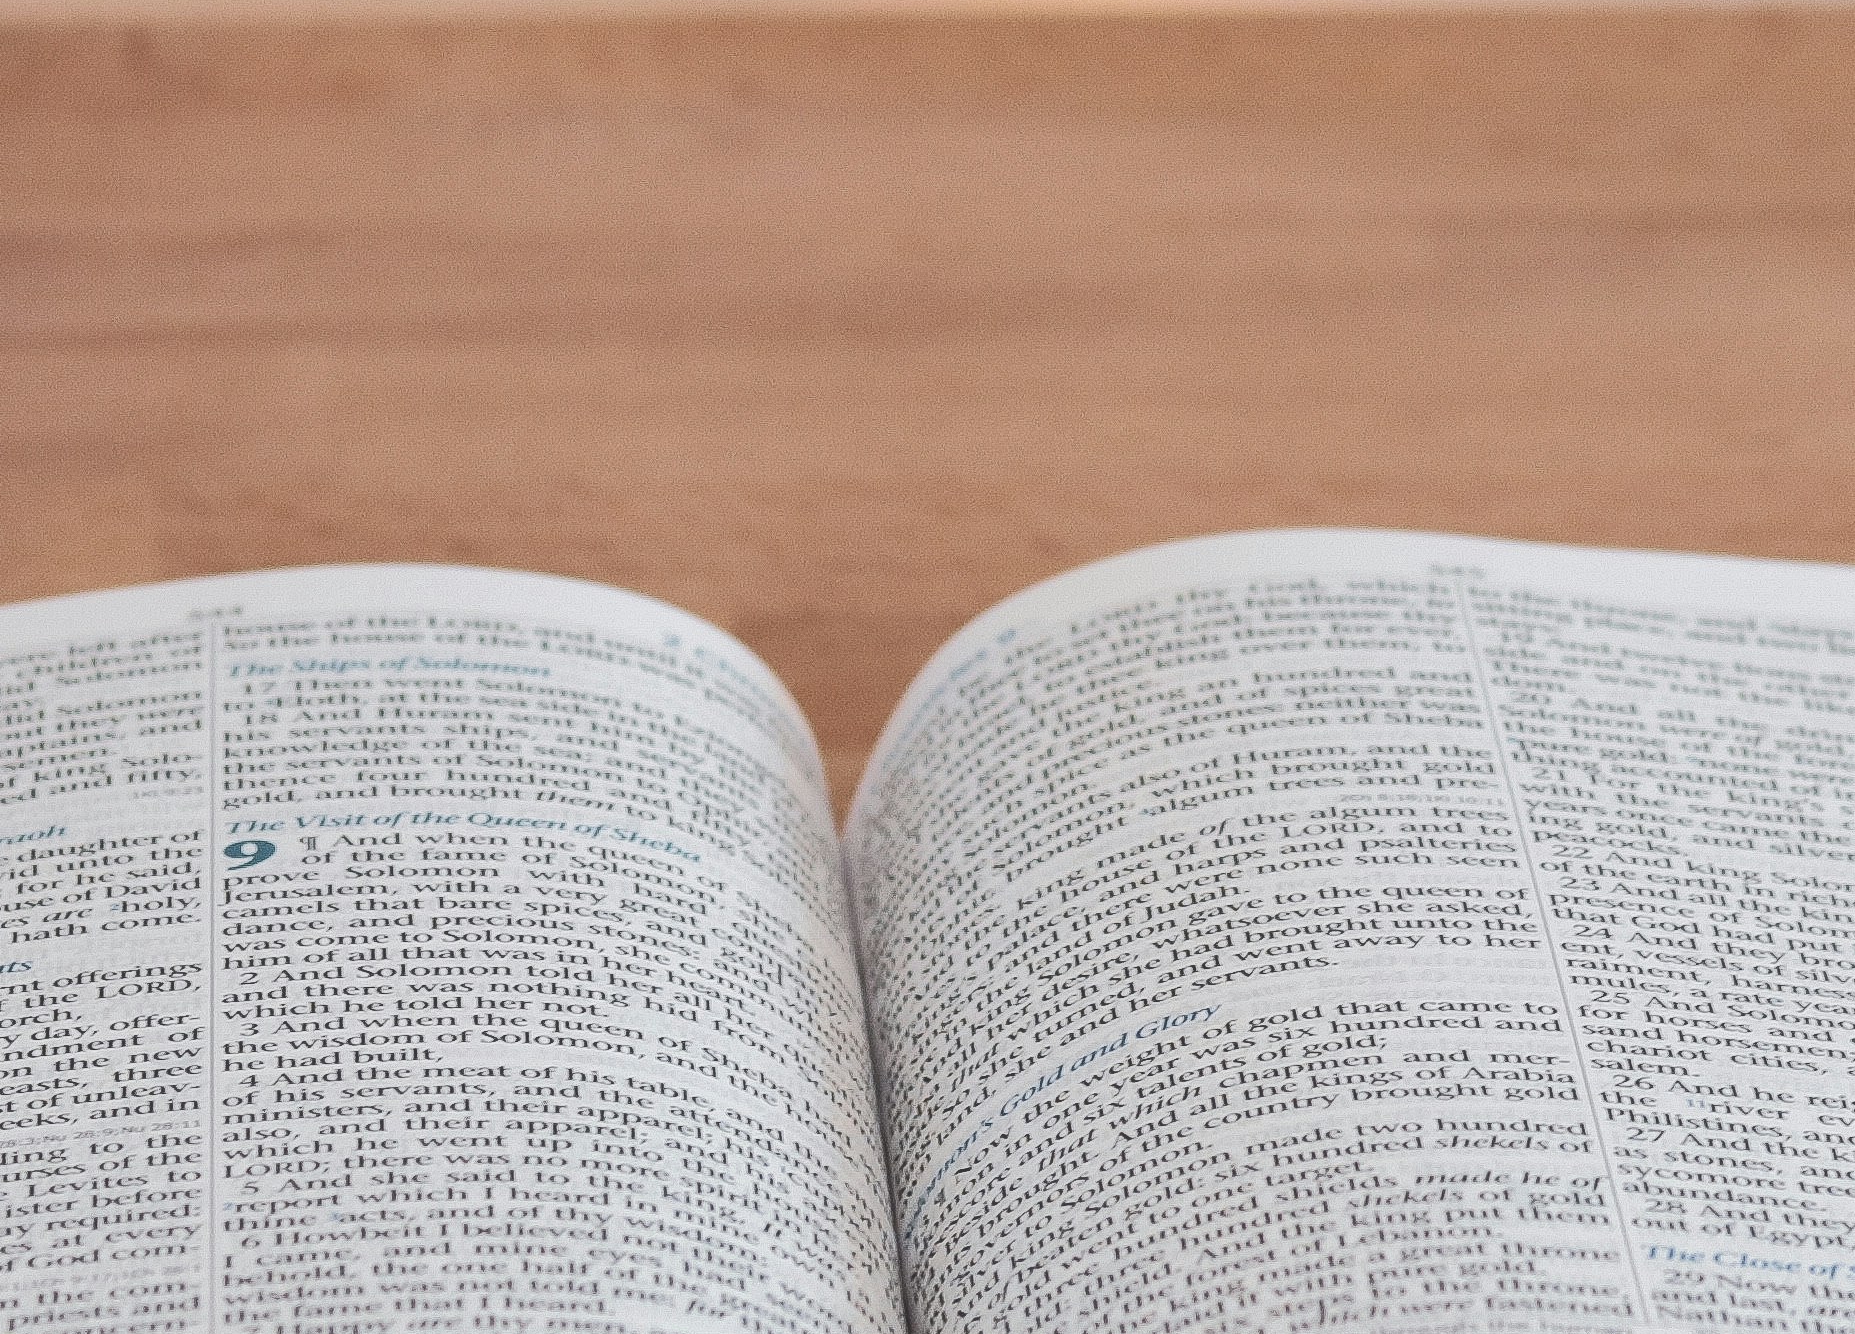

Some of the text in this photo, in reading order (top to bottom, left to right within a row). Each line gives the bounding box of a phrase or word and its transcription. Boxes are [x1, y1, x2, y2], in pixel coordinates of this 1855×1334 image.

[227, 811, 701, 863] The Visit of the Queen of Sheba
[223, 839, 277, 871] 9
[223, 929, 604, 954] was come to Solomon,
[224, 946, 589, 970] him of all that was in
[24, 993, 78, 1009] the
[223, 996, 608, 1020] which he told her not.
[1591, 989, 1630, 1005] 25
[1645, 996, 1716, 1014] And
[31, 1025, 98, 1041] day,
[109, 1013, 199, 1031] offer-
[241, 1013, 643, 1040] 3 And when the queen
[223, 1029, 645, 1059] the wisdom of Solomon,
[1080, 1000, 1558, 1087] weight of gold that came to
[1110, 1015, 1563, 1098] year was six hundred and
[1586, 1039, 1711, 1062] chariot
[1730, 1052, 1828, 1075] cities,
[53, 1057, 109, 1072] the
[130, 1047, 201, 1064] new
[224, 1048, 442, 1072] he had built,
[1000, 1004, 1221, 1117] Gold and Glory
[1137, 1034, 1386, 1099] talents of gold;
[1591, 1058, 1700, 1078] salem.
[1613, 1074, 1655, 1090] 26
[1668, 1079, 1739, 1098] And
[1753, 1087, 1794, 1103] he
[1112, 1065, 1575, 1149] And all the kings of Arabia
[1141, 1083, 1579, 1153] the country brought gold
[1605, 1107, 1792, 1141] Philistines,
[1647, 1245, 1705, 1262] The
[1713, 1251, 1802, 1273] Close
[1809, 1262, 1841, 1281] of
